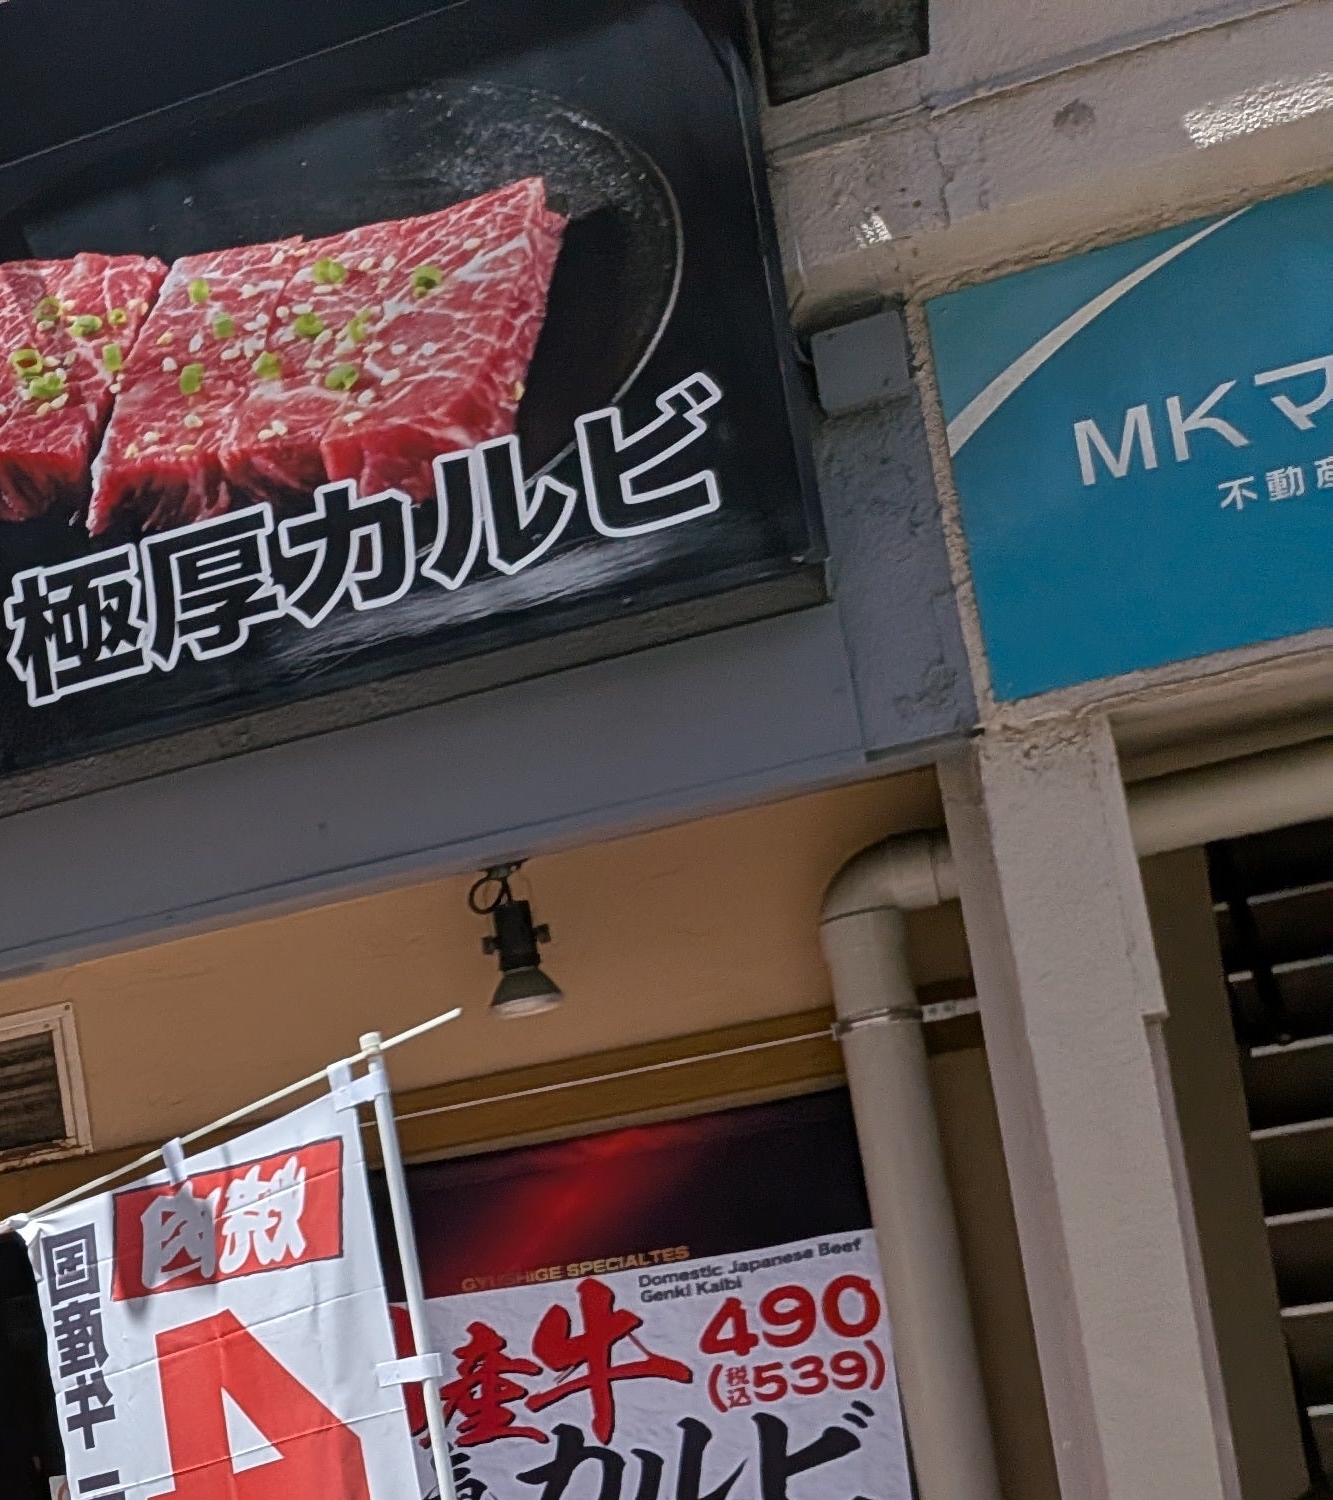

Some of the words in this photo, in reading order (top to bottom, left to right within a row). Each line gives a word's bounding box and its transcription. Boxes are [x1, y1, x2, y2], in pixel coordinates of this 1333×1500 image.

[4, 371, 722, 708] 極厚カルビ
[638, 1264, 725, 1288] Domestic
[728, 1247, 814, 1273] Japanese
[818, 1237, 862, 1258] Beef
[640, 1283, 691, 1303] Genki
[699, 1273, 882, 1356] 490
[393, 1277, 693, 1447] 産牛
